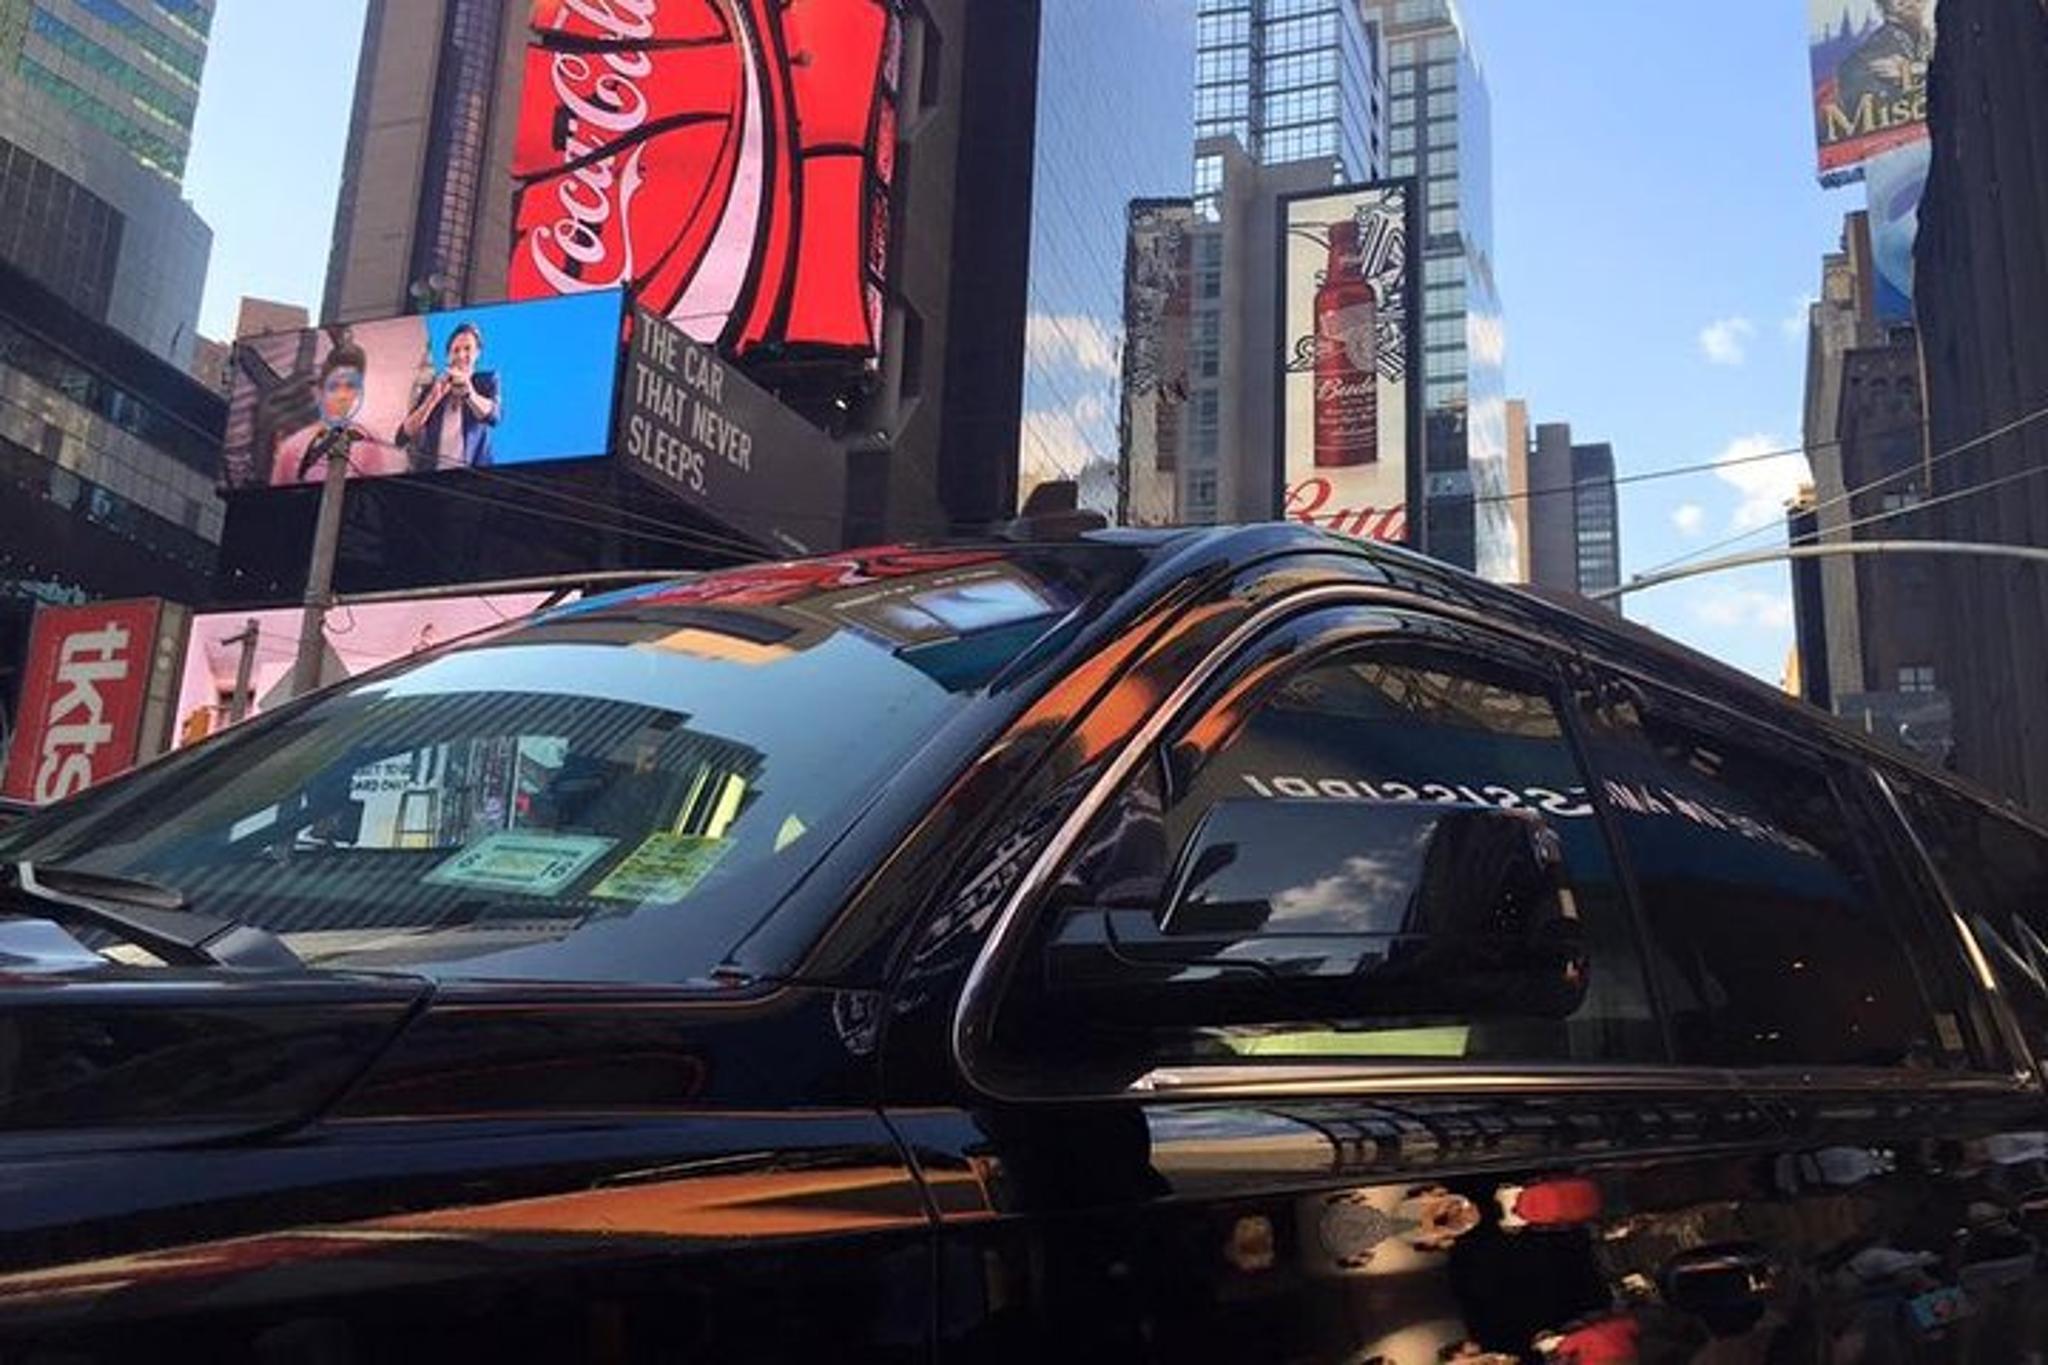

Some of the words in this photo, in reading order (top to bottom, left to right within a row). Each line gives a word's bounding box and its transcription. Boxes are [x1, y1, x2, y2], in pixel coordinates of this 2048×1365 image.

[642, 313, 678, 372] THE
[684, 346, 724, 403] CAR
[627, 415, 707, 495] SLEEPS.
[636, 362, 687, 427] THAT
[691, 401, 752, 472] NEVER
[35, 623, 130, 806] tkts
